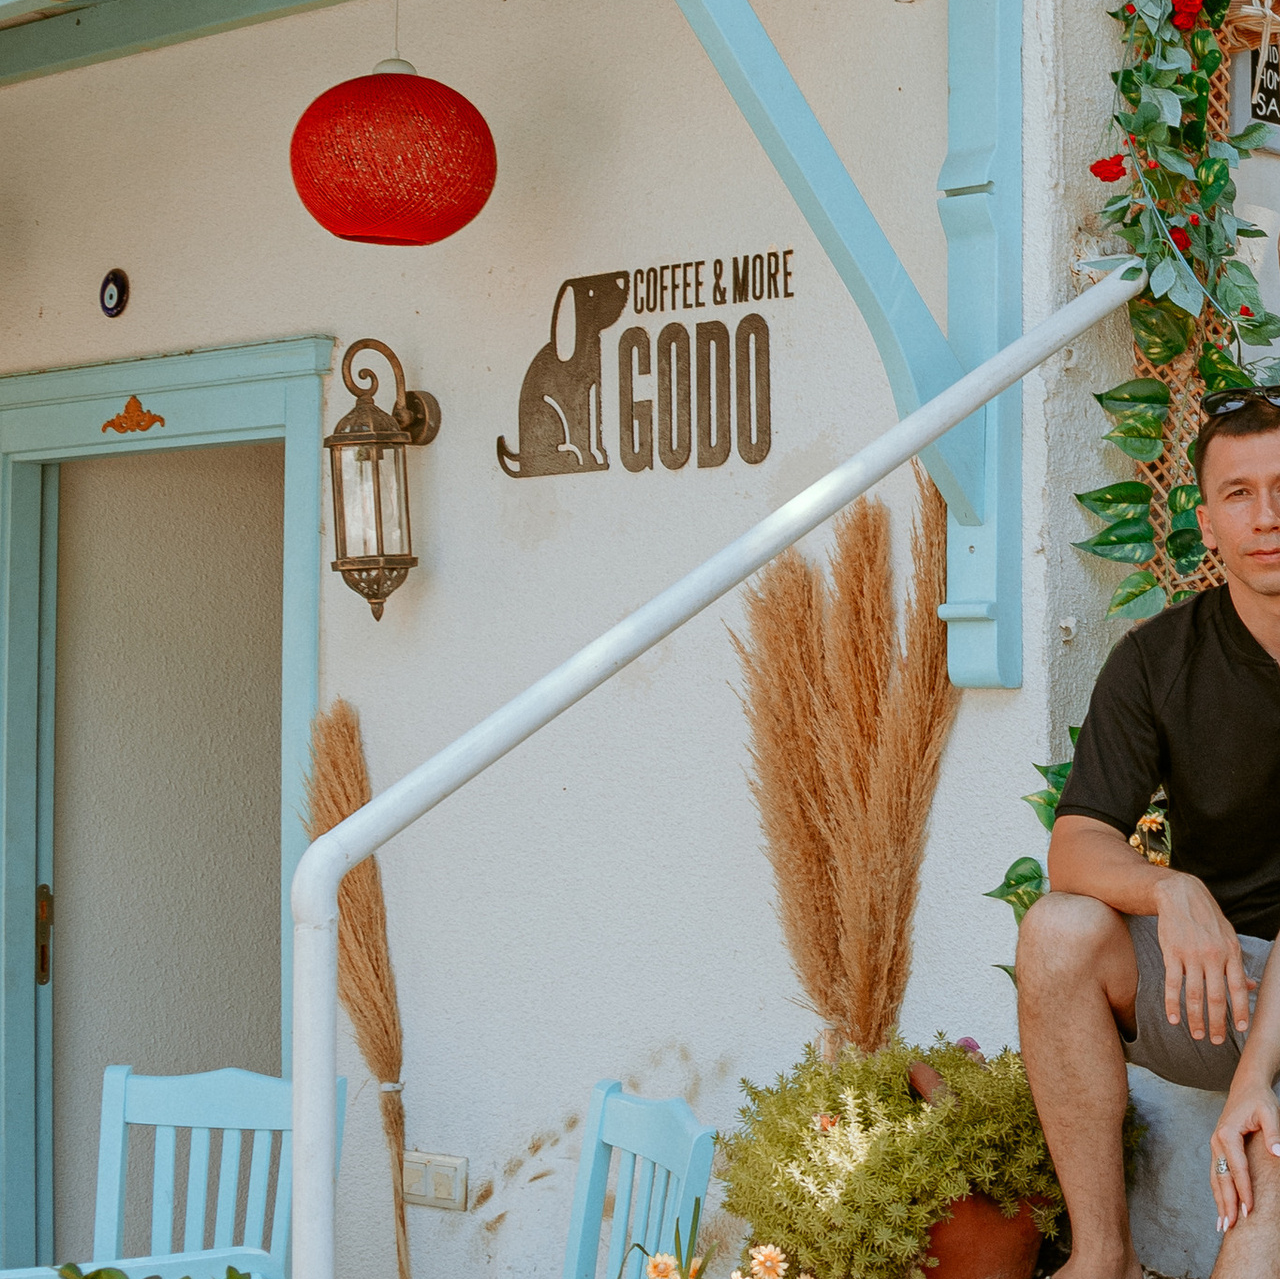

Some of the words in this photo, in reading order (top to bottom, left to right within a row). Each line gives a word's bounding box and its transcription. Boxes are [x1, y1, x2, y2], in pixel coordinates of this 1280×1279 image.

[634, 260, 706, 315] COFFEE
[712, 258, 727, 306] &
[732, 249, 794, 304] MORE
[618, 312, 771, 473] GODO
